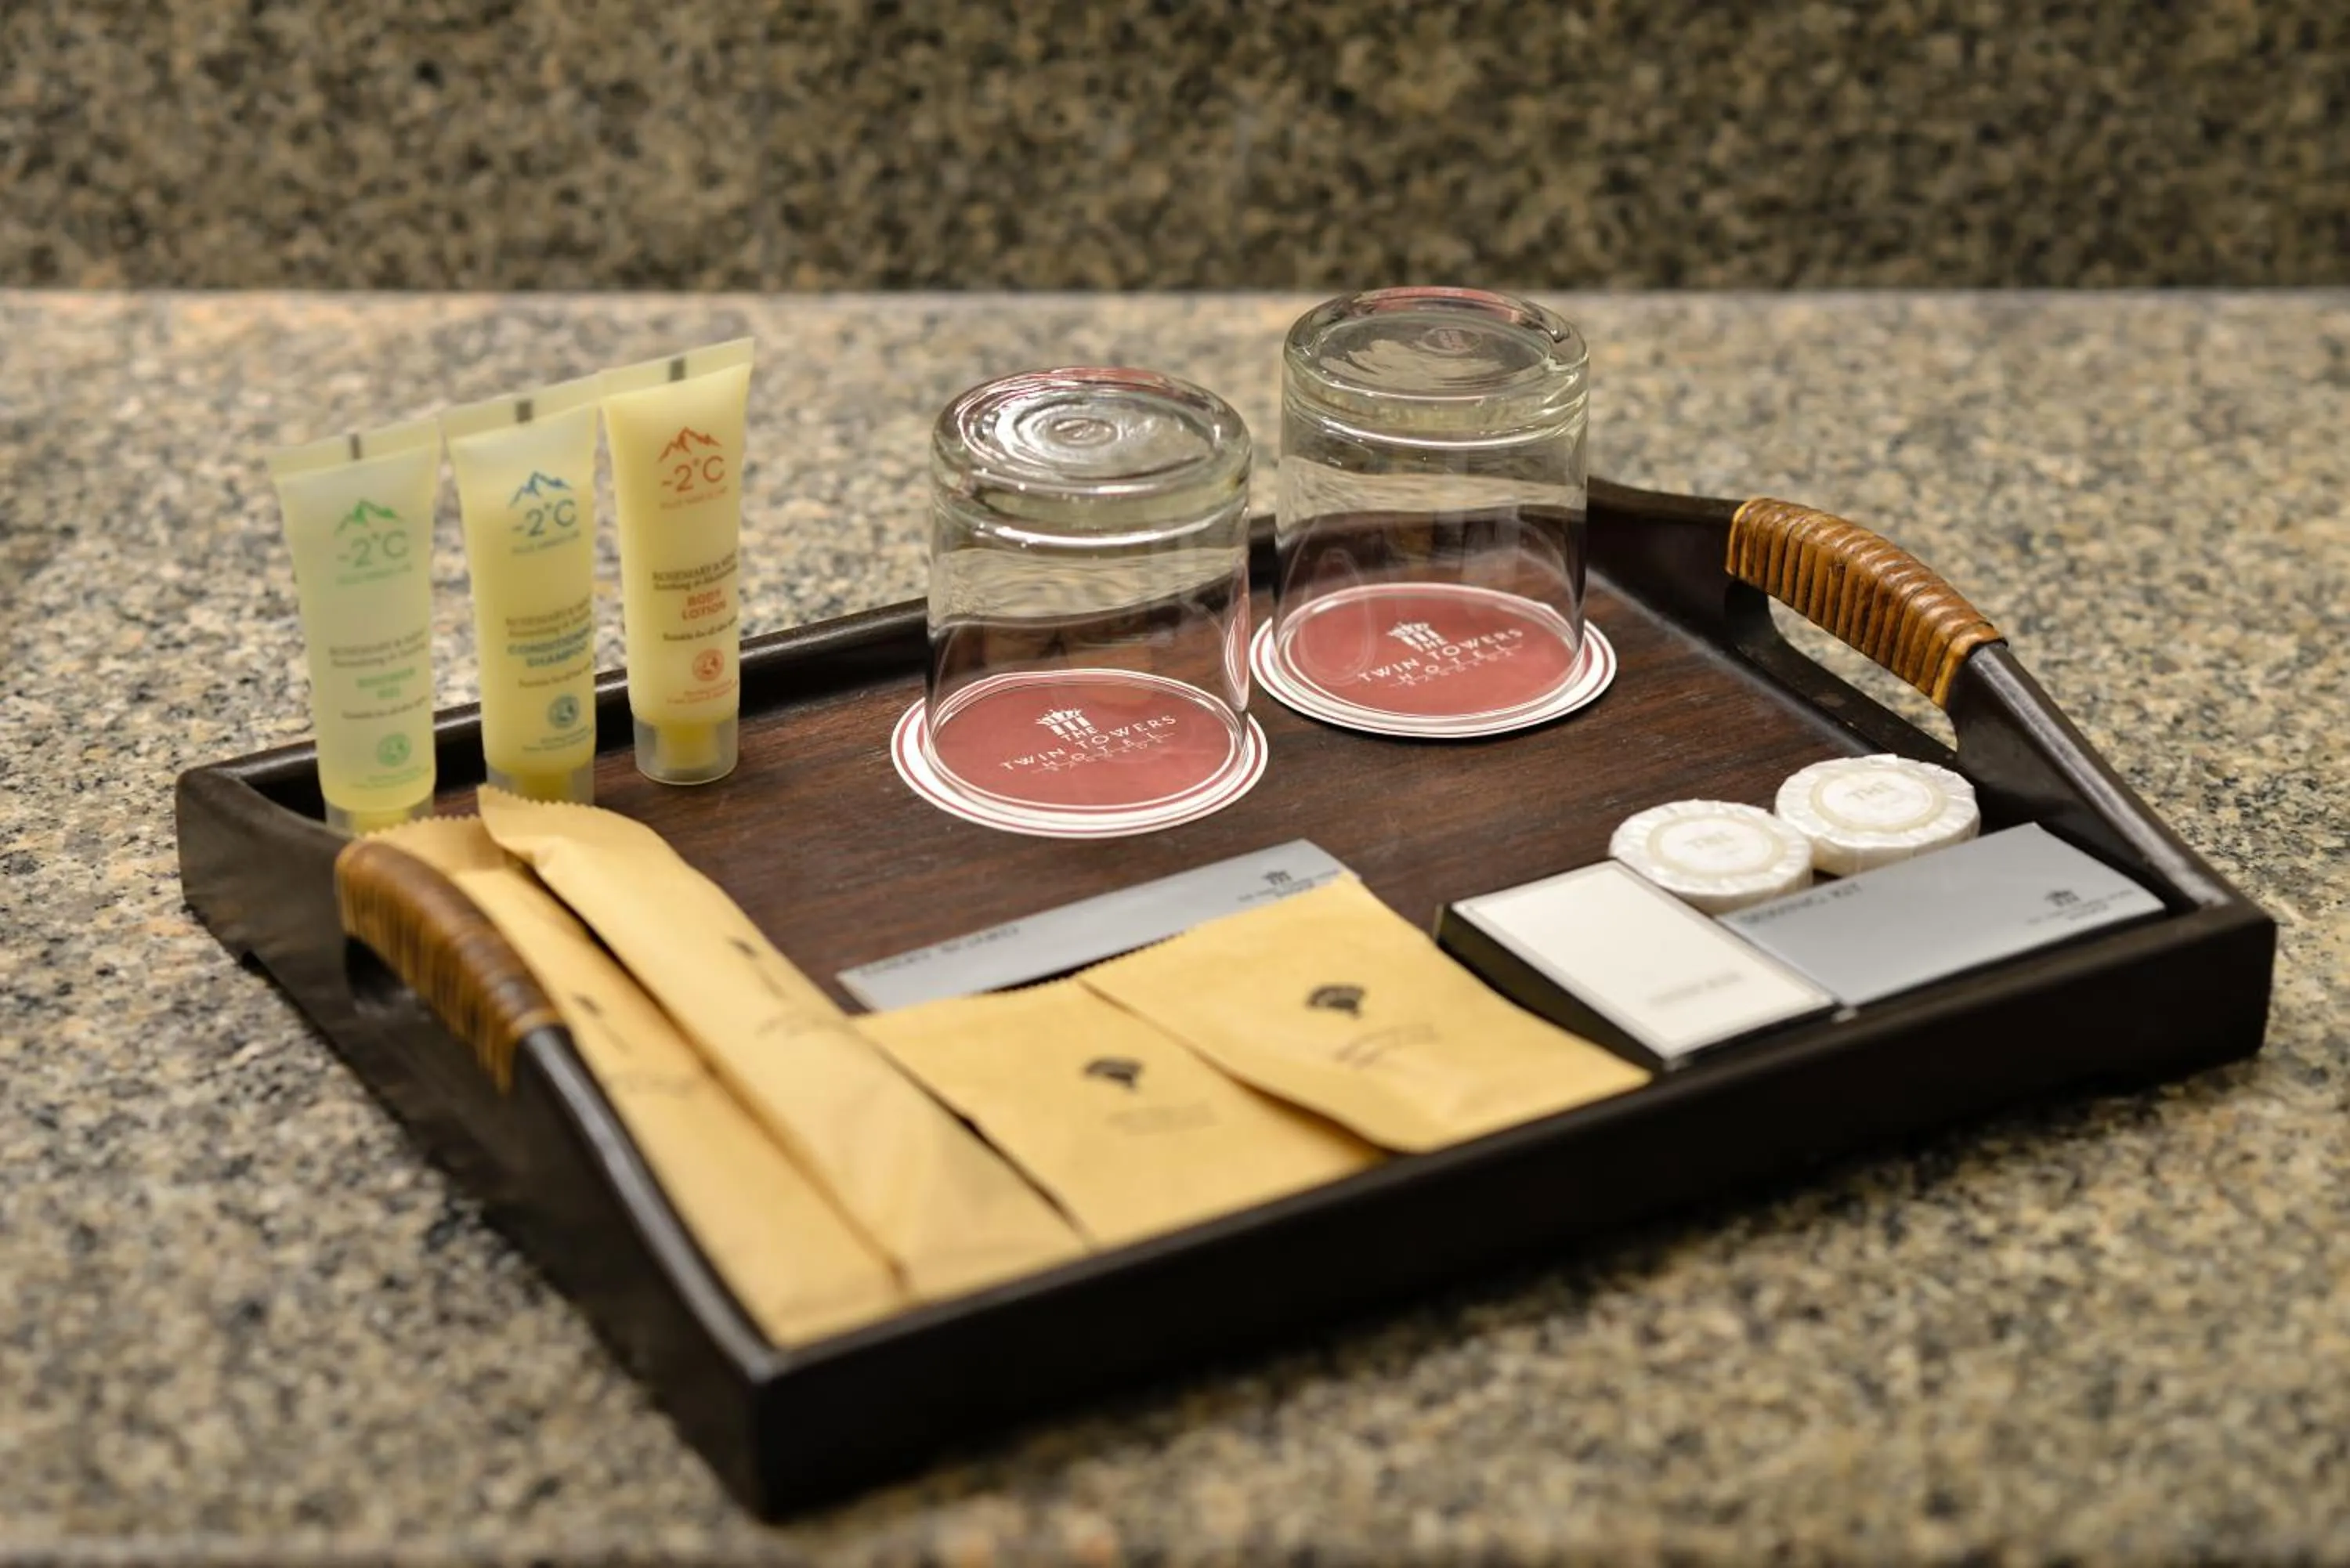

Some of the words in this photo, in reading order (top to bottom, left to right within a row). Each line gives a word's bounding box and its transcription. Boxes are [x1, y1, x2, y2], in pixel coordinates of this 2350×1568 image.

[682, 600, 727, 621] LOTION
[1358, 658, 1420, 682] TWIN
[1426, 629, 1523, 661] TOWERS
[999, 748, 1065, 771] TWIN
[1075, 715, 1177, 750] TOWERS
